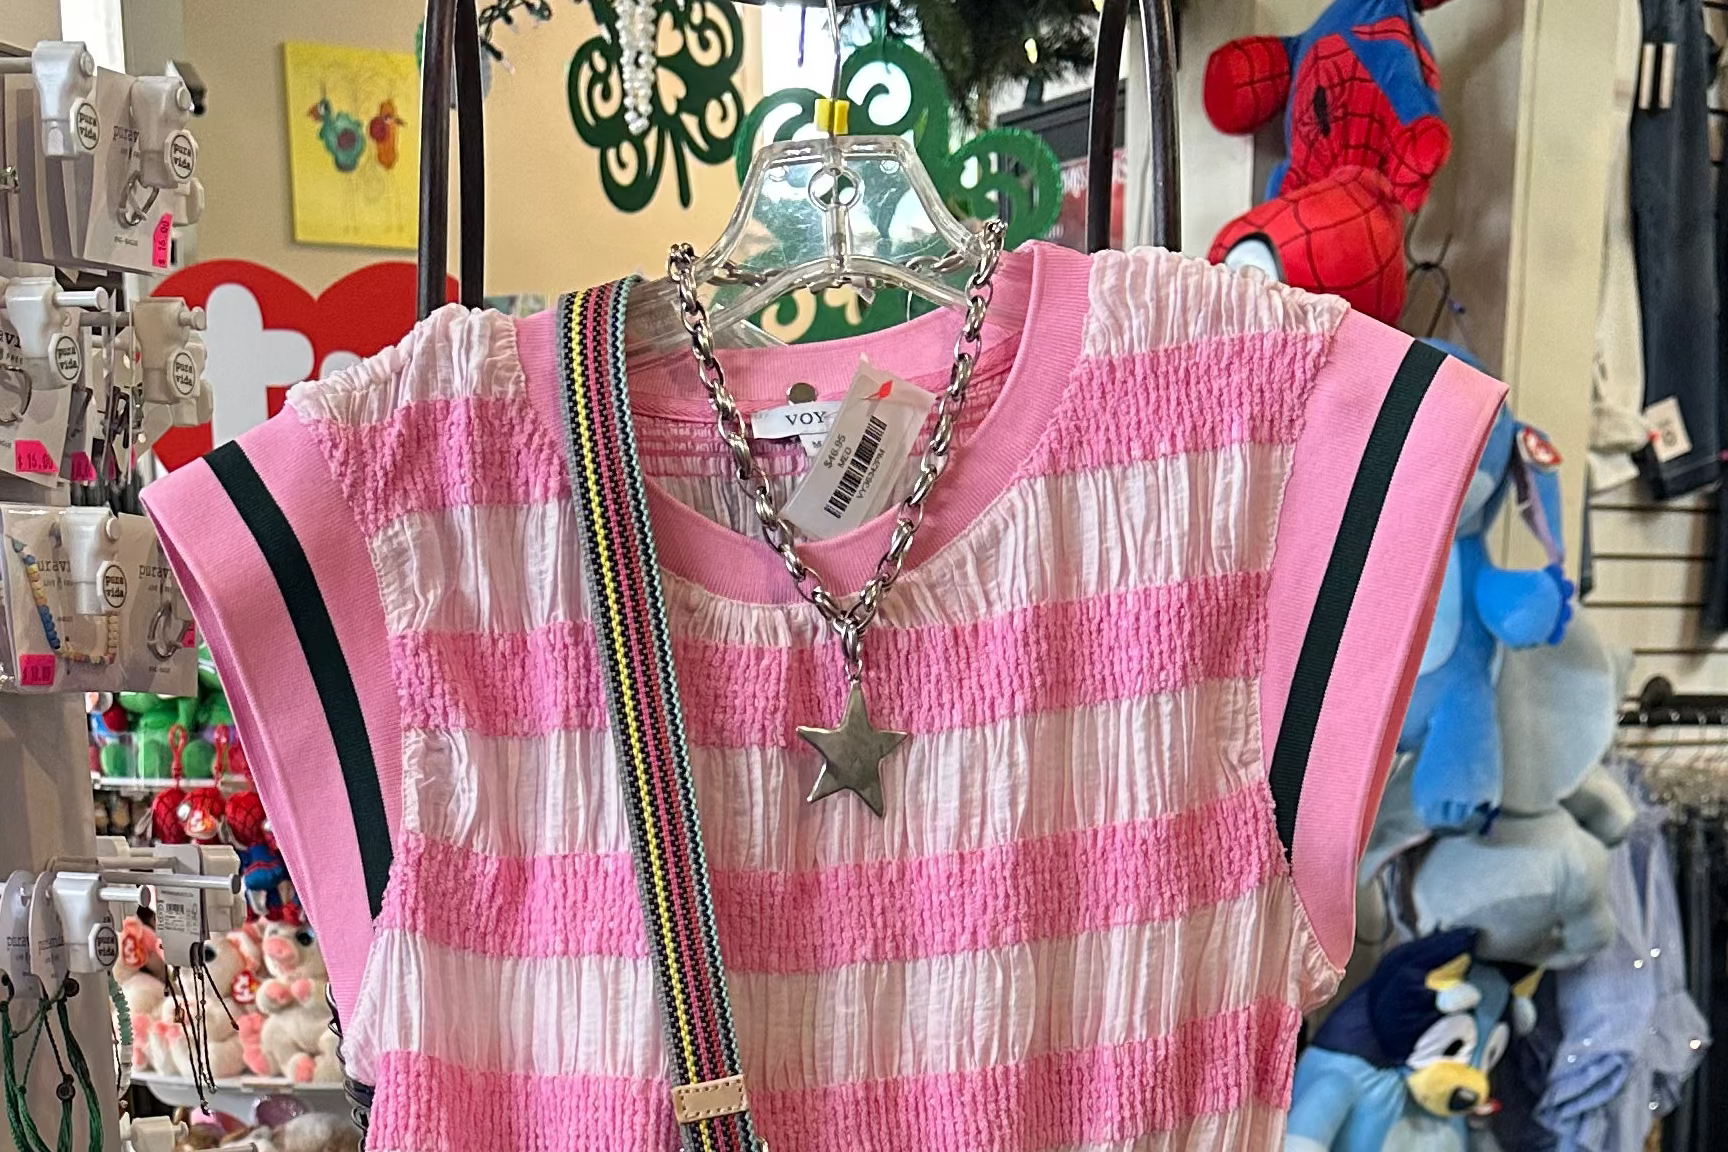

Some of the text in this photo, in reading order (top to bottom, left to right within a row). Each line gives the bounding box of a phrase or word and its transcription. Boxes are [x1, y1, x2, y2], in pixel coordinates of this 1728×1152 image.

[79, 112, 97, 126] pura
[79, 126, 97, 141] vida
[174, 143, 191, 157] pura
[174, 157, 191, 171] vida
[58, 346, 76, 359] pura
[59, 358, 78, 370] vida
[176, 361, 193, 374] pura
[176, 374, 193, 387] vida
[837, 446, 852, 469] MED
[105, 575, 124, 586] pura
[106, 587, 124, 598] vida
[98, 937, 114, 946] pura
[98, 947, 114, 957] vida
